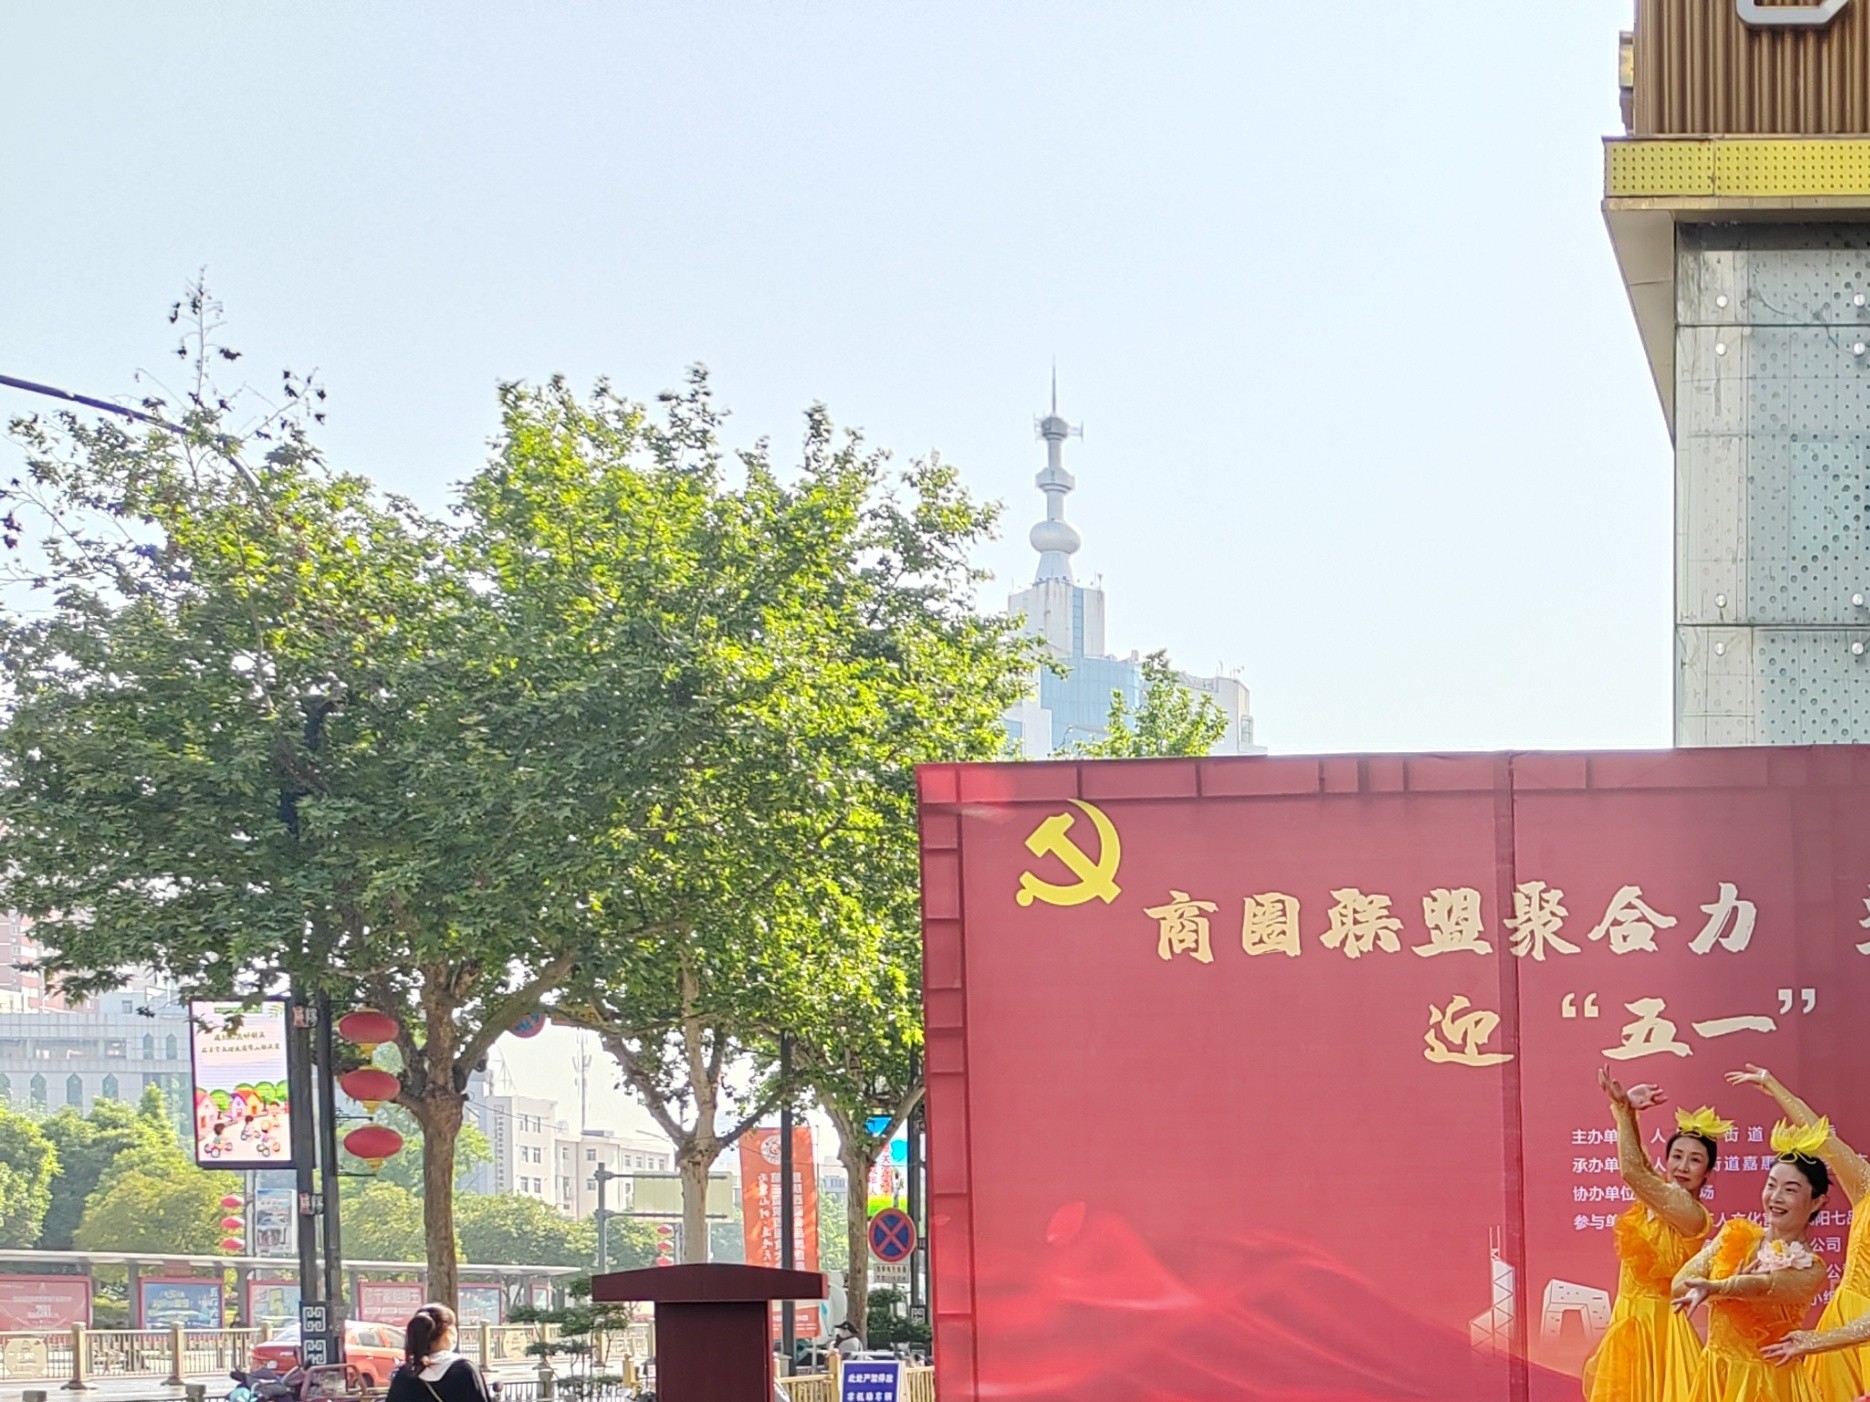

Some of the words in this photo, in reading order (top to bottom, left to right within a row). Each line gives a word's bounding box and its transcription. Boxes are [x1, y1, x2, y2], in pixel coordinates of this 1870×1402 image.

[1143, 880, 1758, 964] 商圈联盟聚合力
